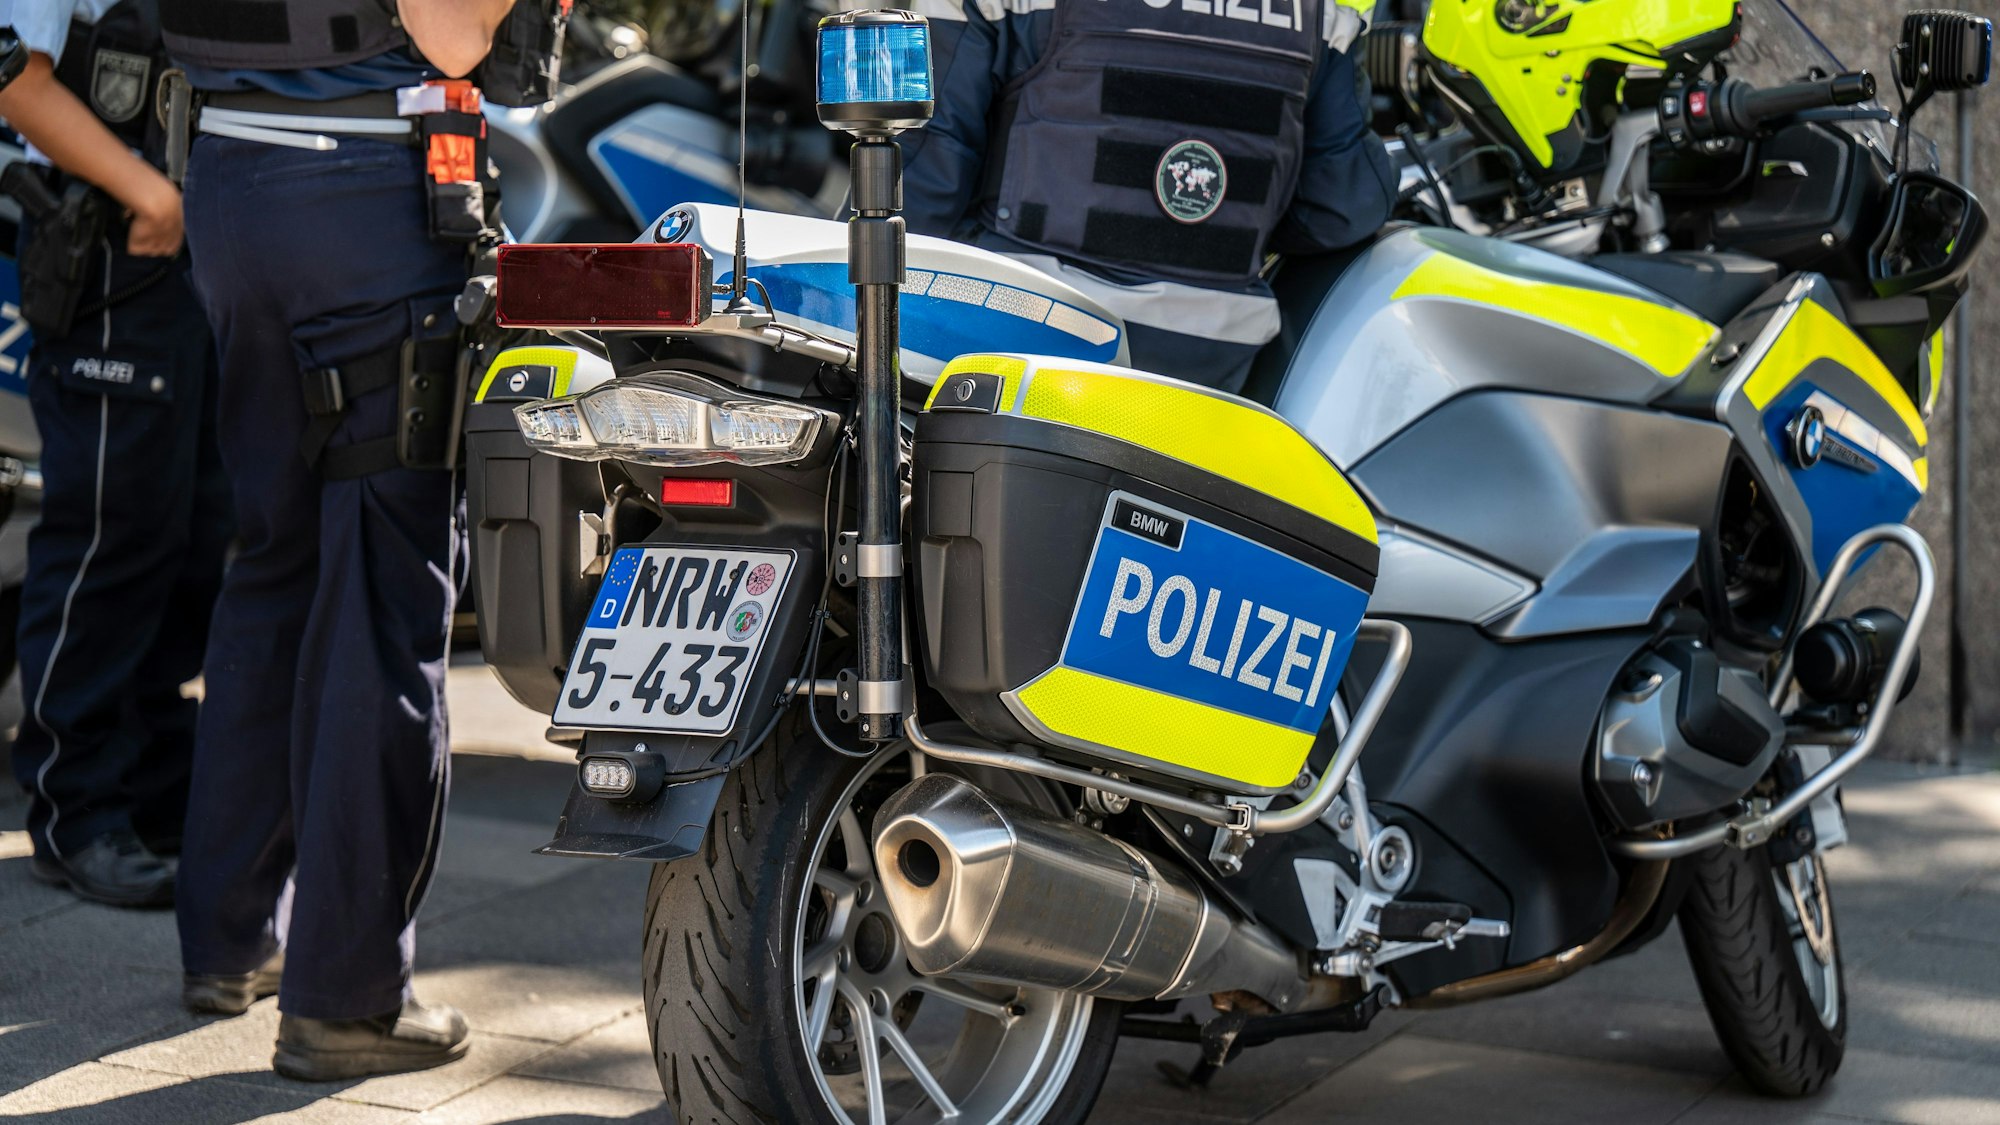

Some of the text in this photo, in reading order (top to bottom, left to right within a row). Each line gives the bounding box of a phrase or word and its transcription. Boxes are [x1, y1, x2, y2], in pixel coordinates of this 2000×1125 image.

[72, 358, 135, 384] POLIZEI
[1130, 510, 1170, 538] BMW
[600, 598, 617, 619] D
[621, 556, 749, 632] NRW
[1099, 556, 1337, 708] POLIZEI
[568, 637, 750, 718] 5-433
